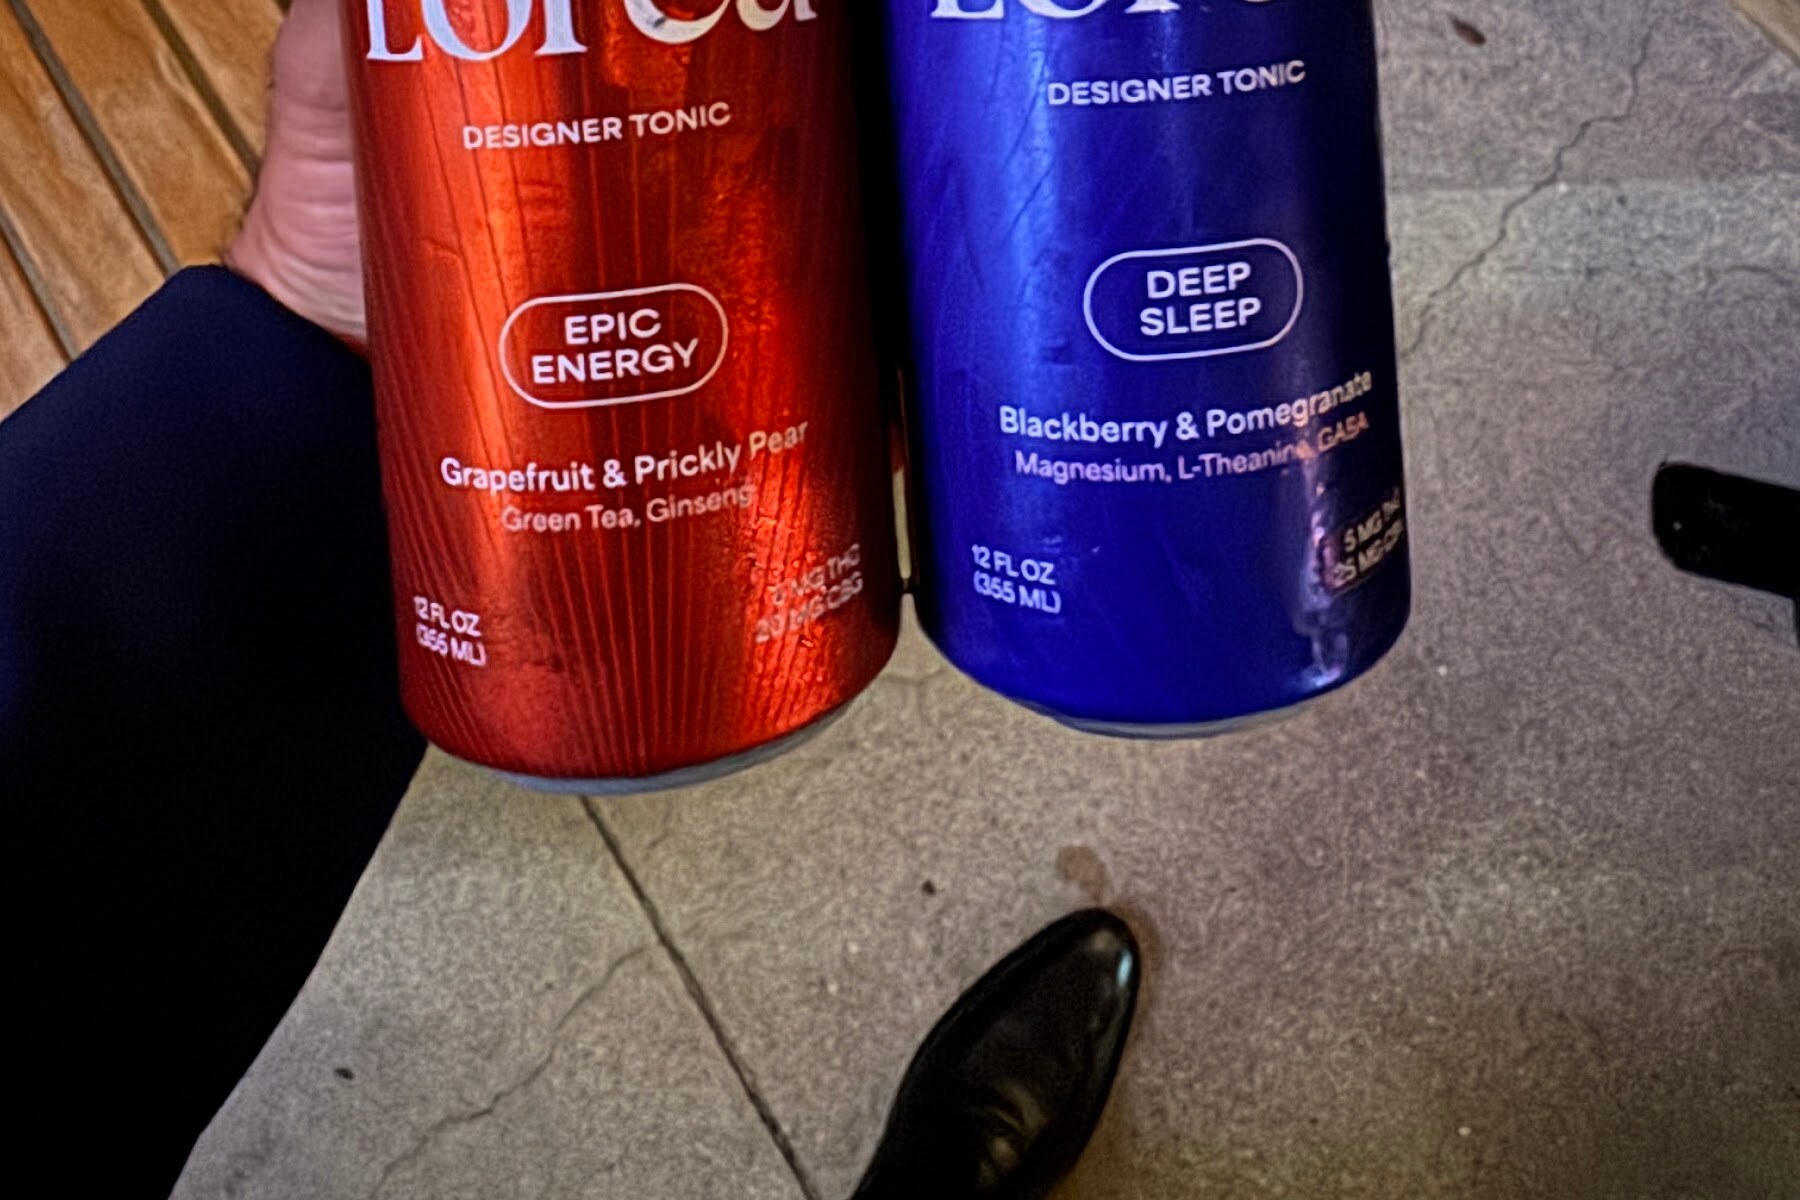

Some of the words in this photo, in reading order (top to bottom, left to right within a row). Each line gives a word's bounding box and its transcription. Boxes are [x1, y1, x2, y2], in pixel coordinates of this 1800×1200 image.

[1049, 73, 1212, 106] DESIGNER
[1217, 59, 1306, 94] TONIC
[462, 116, 623, 150] DESIGNER
[628, 102, 732, 137] TONIC
[1147, 262, 1252, 299] DEEP
[564, 308, 661, 345] EPIC
[1140, 297, 1260, 336] SLEEP
[532, 338, 698, 384] ENERGY
[1000, 405, 1168, 448] Blackberry
[1175, 411, 1200, 441] &
[1206, 371, 1372, 437] Pomegranate
[440, 457, 596, 494] Grapefruit
[603, 459, 628, 488] &
[635, 440, 742, 484] Prickly
[749, 421, 808, 460] Pear
[1015, 450, 1172, 484] Magnesium,
[502, 505, 581, 532] Green
[585, 504, 641, 528] Tea,
[646, 484, 757, 522] Ginseng
[972, 544, 991, 569] 12
[993, 550, 1019, 577] FL
[1021, 559, 1056, 585] OZ
[1019, 585, 1061, 614] ML)
[451, 610, 482, 637] OZ
